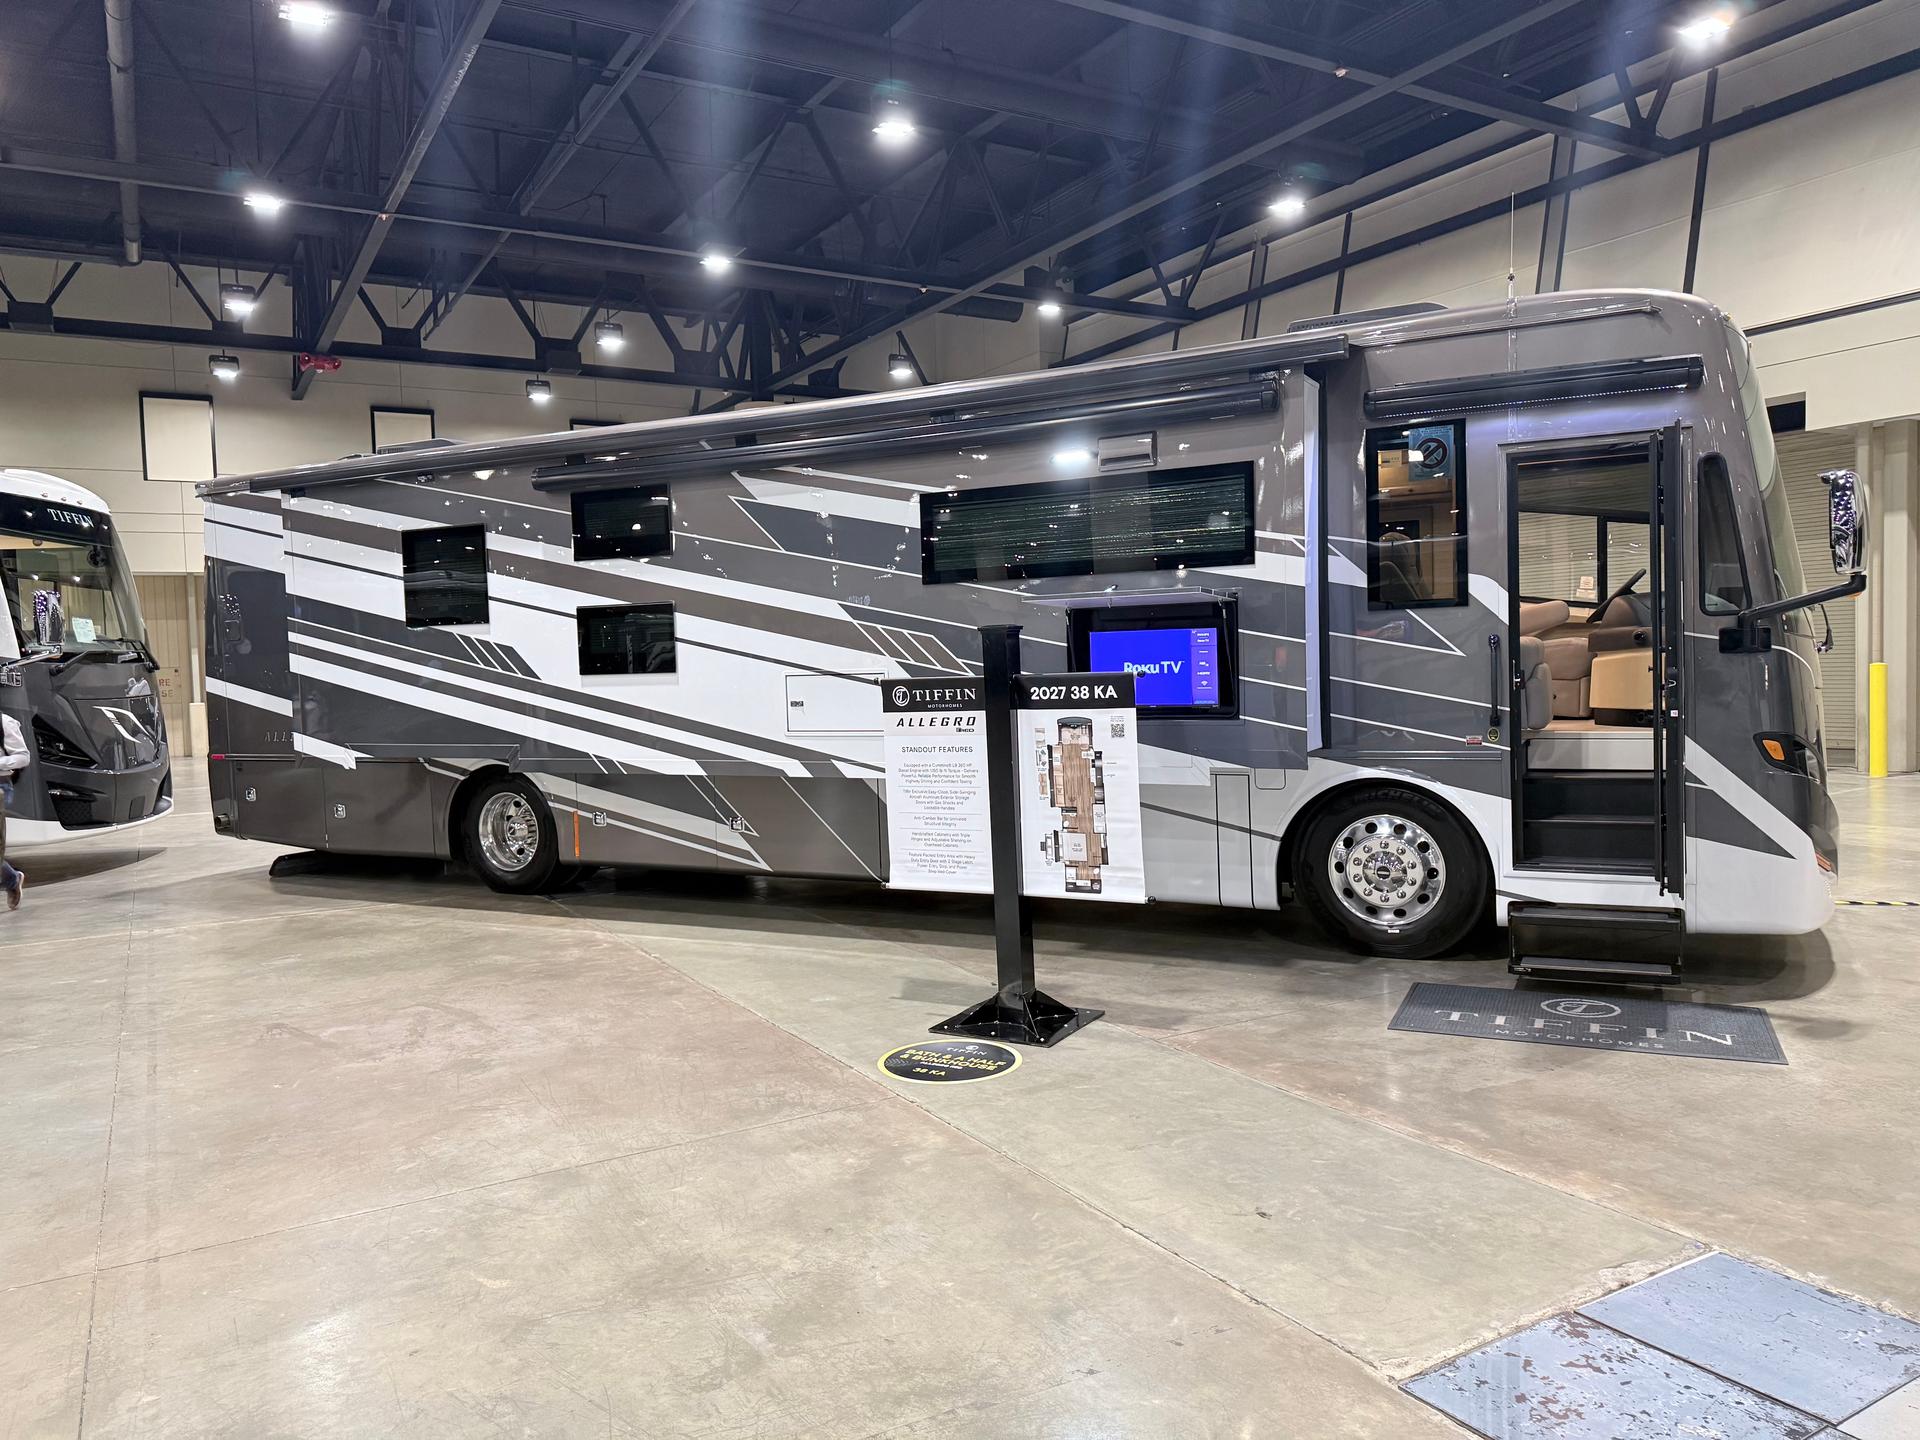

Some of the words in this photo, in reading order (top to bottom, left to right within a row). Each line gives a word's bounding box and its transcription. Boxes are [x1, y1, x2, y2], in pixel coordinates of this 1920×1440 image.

[47, 508, 94, 528] TIFFIN
[1123, 662, 1160, 673] Roku
[1161, 661, 1182, 673] TV
[158, 678, 170, 686] RE
[161, 690, 174, 698] SE
[913, 688, 976, 701] TIFFIN
[1030, 686, 1066, 700] 2027
[1070, 686, 1089, 699] 38
[1094, 685, 1118, 698] KA
[897, 717, 976, 727] ALLEGRO
[1434, 1009, 1737, 1046] TIFFIN
[1496, 1028, 1665, 1049] MOTORHOMES
[904, 1049, 939, 1059] BATH
[967, 1056, 1007, 1066] HALF
[947, 1047, 988, 1056] TIFFIN
[912, 1055, 998, 1071] BUNKHOUSE
